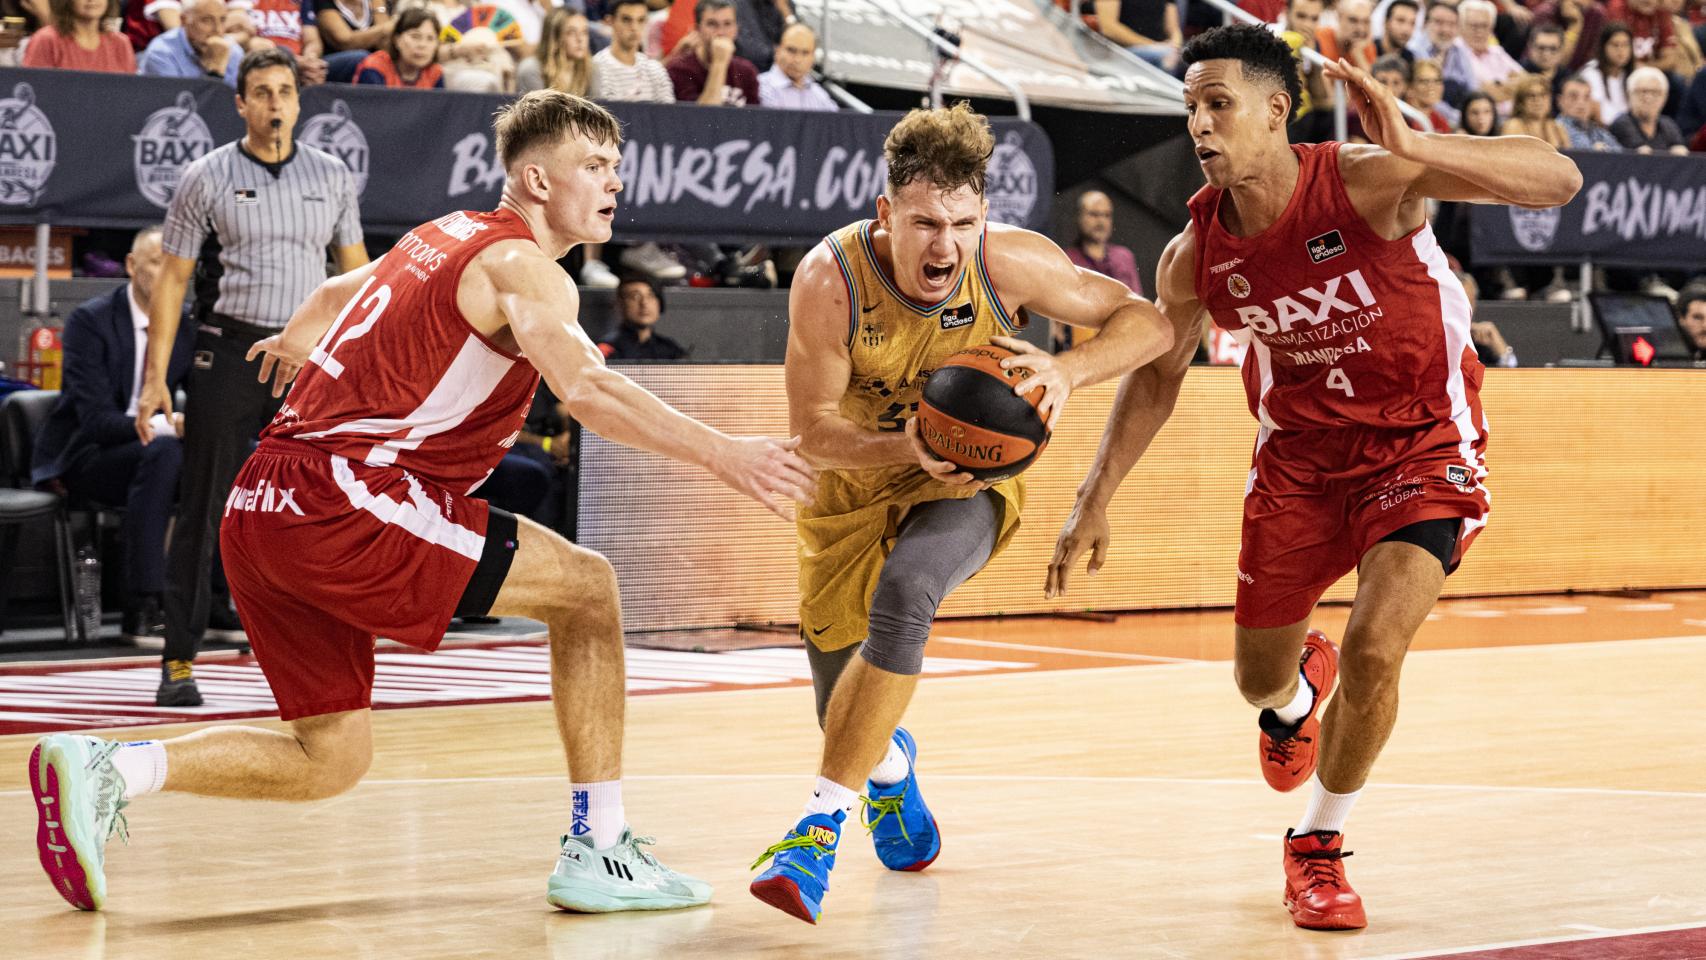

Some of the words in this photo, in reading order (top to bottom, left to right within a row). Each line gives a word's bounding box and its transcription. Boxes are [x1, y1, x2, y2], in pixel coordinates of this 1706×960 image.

[0, 134, 52, 160] AXI
[1315, 244, 1343, 260] endesa
[1234, 269, 1377, 335] BAXI
[308, 275, 392, 380] 12
[942, 314, 957, 322] liga
[943, 316, 973, 328] endesa
[1326, 367, 1355, 397] 4
[878, 402, 919, 432] 3
[923, 416, 1003, 462] SPALDING
[1450, 472, 1466, 483] acb
[1381, 487, 1427, 510] GLOBAL
[807, 825, 837, 845] UNO
